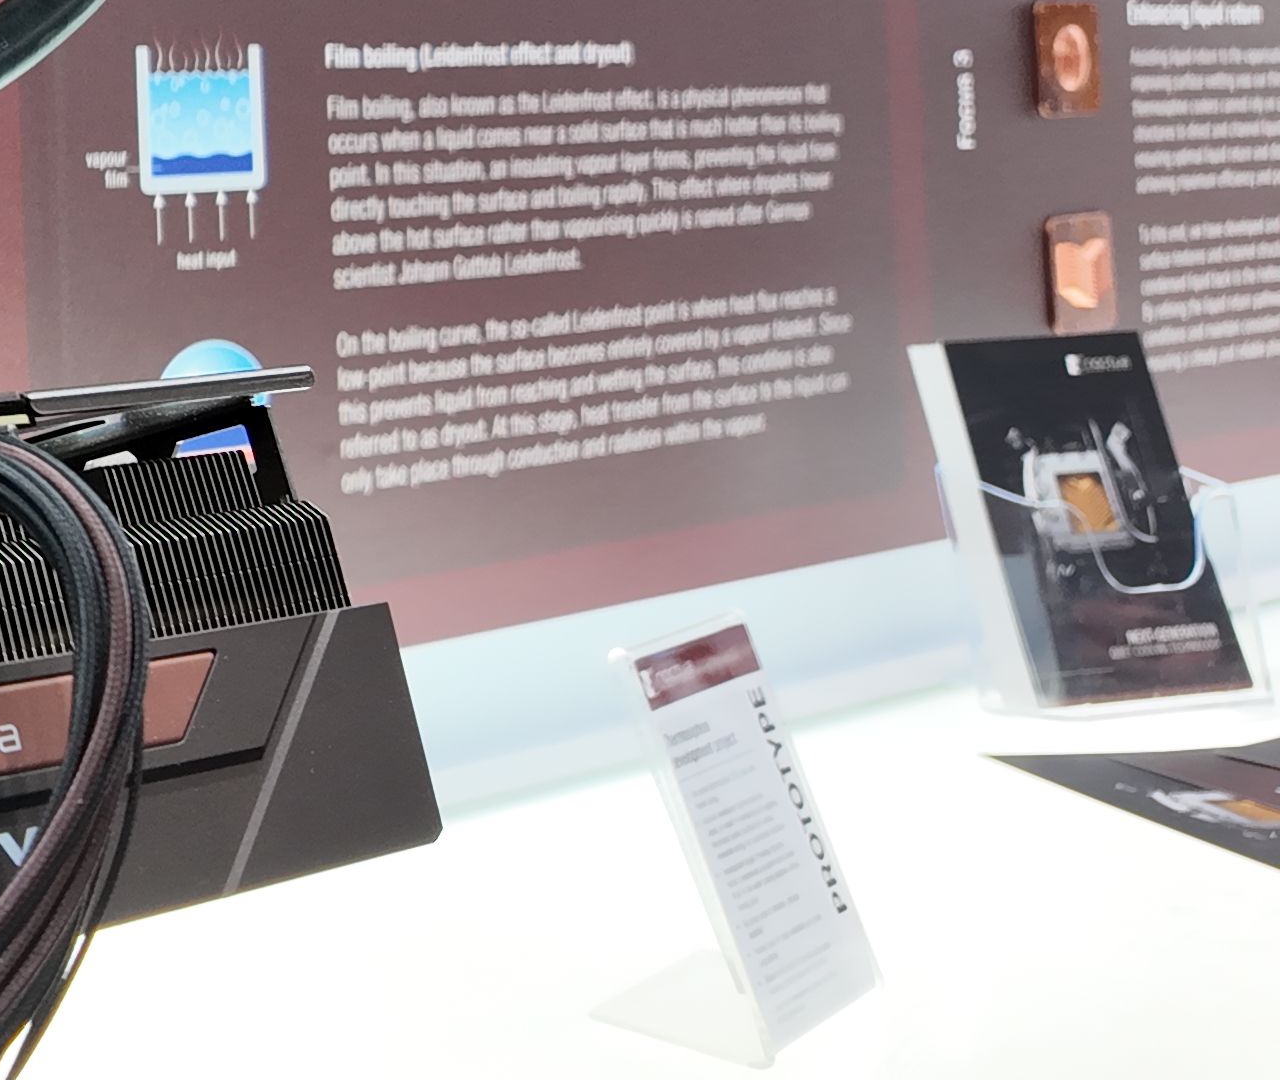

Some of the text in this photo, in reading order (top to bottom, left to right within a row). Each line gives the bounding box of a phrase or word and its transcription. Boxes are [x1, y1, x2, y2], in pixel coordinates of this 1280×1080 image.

[324, 39, 632, 72] Film boiling (Leidenfrost effect and dryout)
[85, 150, 128, 171] vapour
[176, 250, 204, 271] heat
[746, 685, 848, 915] PROTOTYPE
